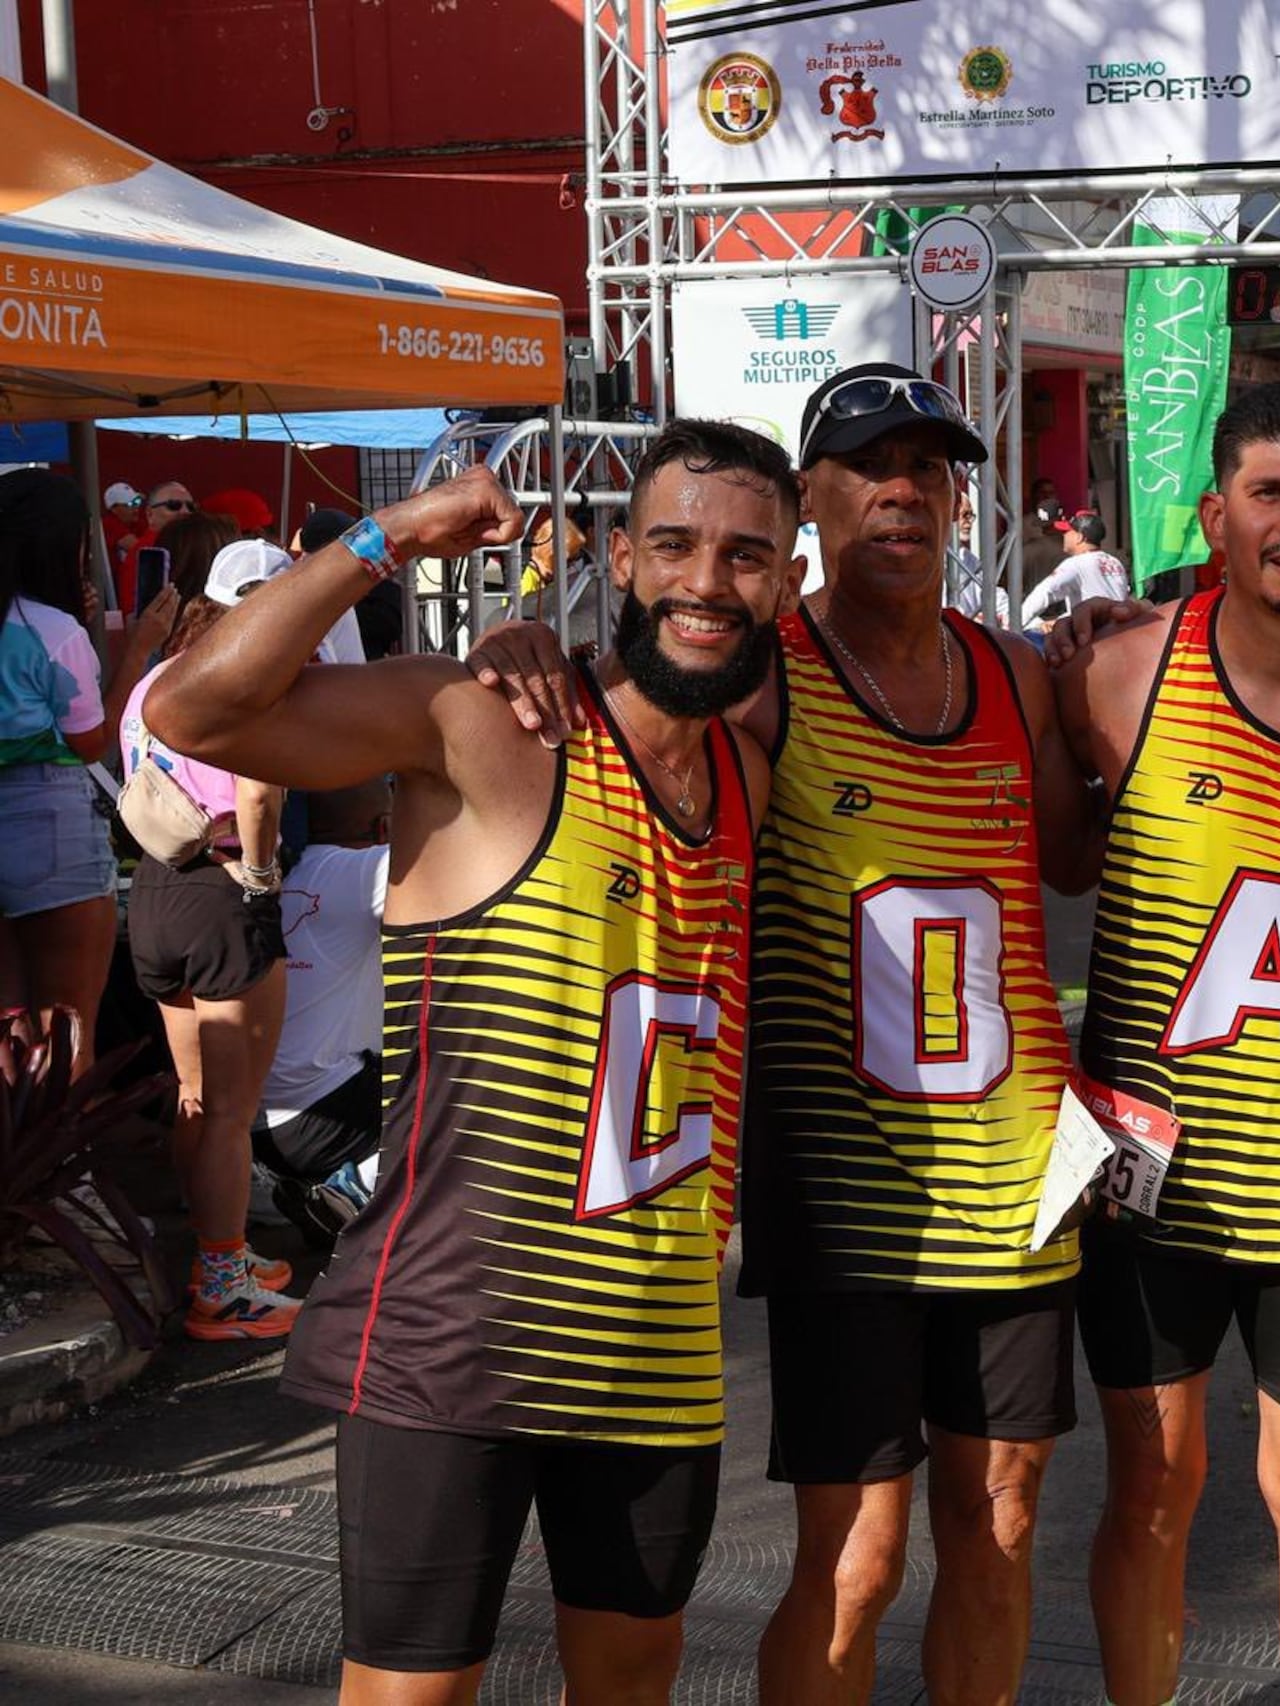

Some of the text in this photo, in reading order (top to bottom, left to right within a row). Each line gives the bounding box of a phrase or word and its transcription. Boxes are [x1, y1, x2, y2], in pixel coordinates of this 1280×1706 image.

[1086, 61, 1166, 79] TURISMO
[1086, 75, 1251, 104] DEPORTIVO
[919, 110, 966, 123] Estrella
[1027, 106, 1055, 118] Soto
[921, 258, 980, 273] BLAS
[923, 246, 968, 260] SAN
[5, 264, 103, 292] E SALUD
[0, 297, 108, 348] ONITA
[378, 322, 545, 367] 1-866-221-9636
[750, 348, 836, 367] SEGUROS
[576, 968, 721, 1222] C
[1139, 1172, 1158, 1214] CORRAL
